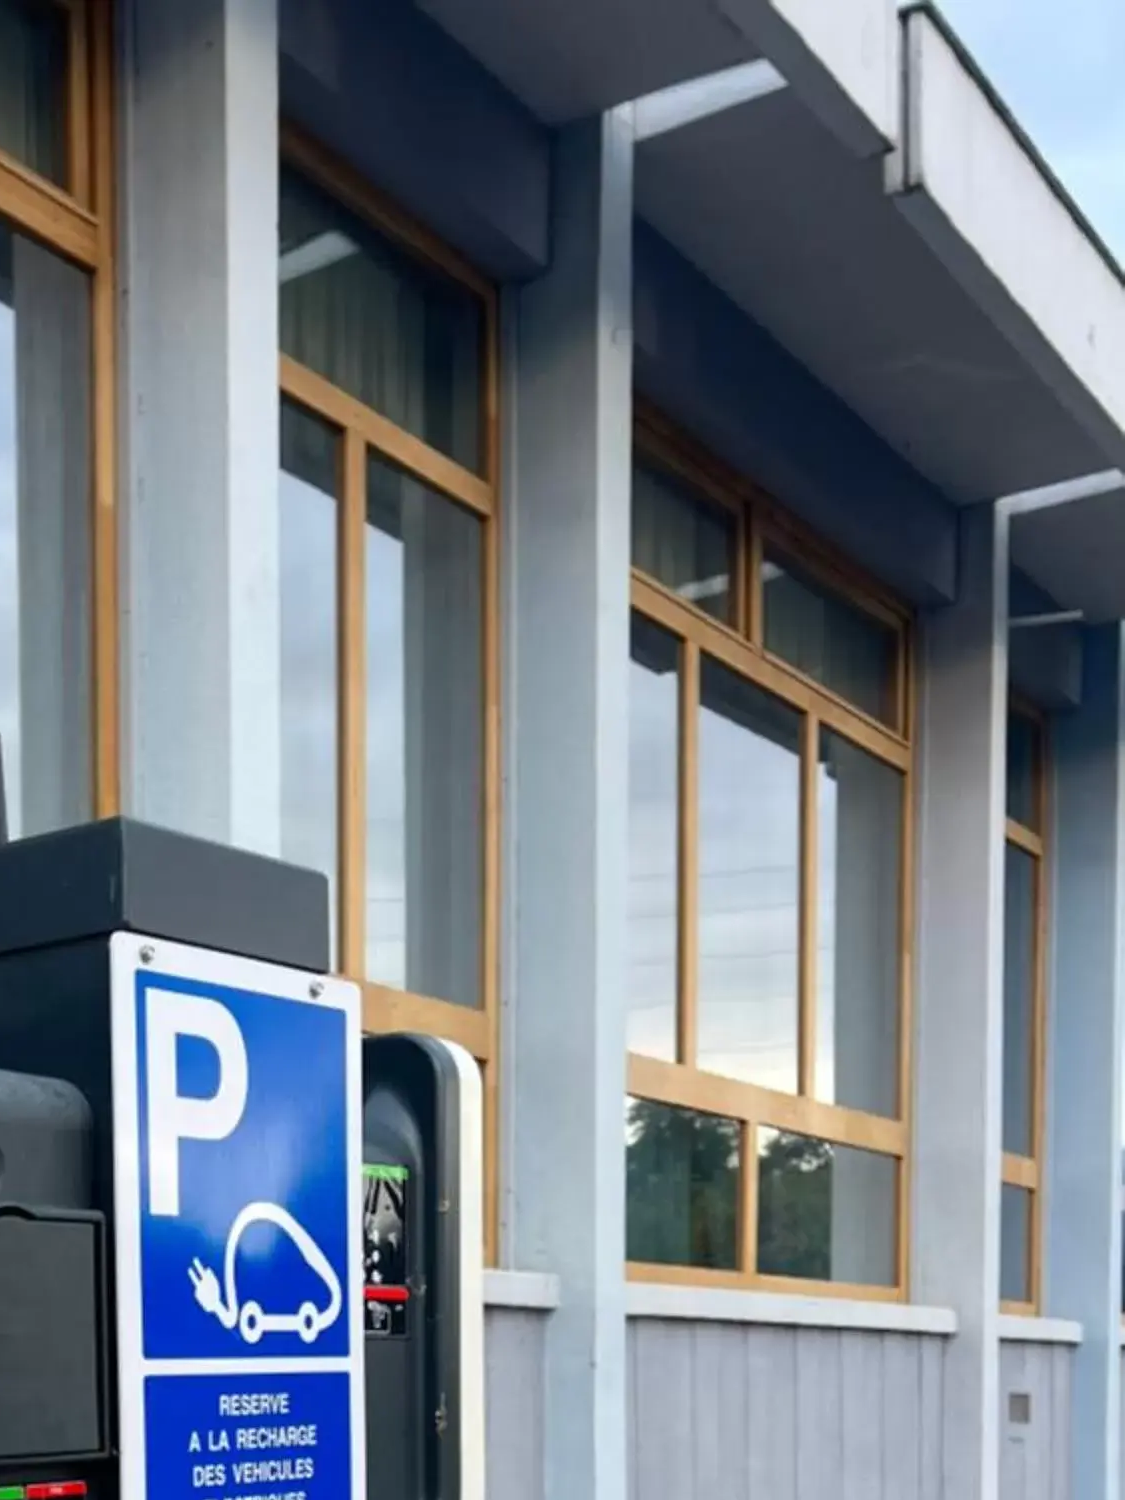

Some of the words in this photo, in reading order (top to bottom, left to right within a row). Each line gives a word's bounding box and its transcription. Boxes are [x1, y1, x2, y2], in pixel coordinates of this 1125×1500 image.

[145, 987, 248, 1217] P
[219, 1393, 290, 1416] RESERVE
[188, 1431, 202, 1452] A
[208, 1429, 230, 1451] LA
[236, 1425, 317, 1450] RECHARGE
[192, 1464, 226, 1488] DES
[232, 1457, 314, 1484] VEHICULES
